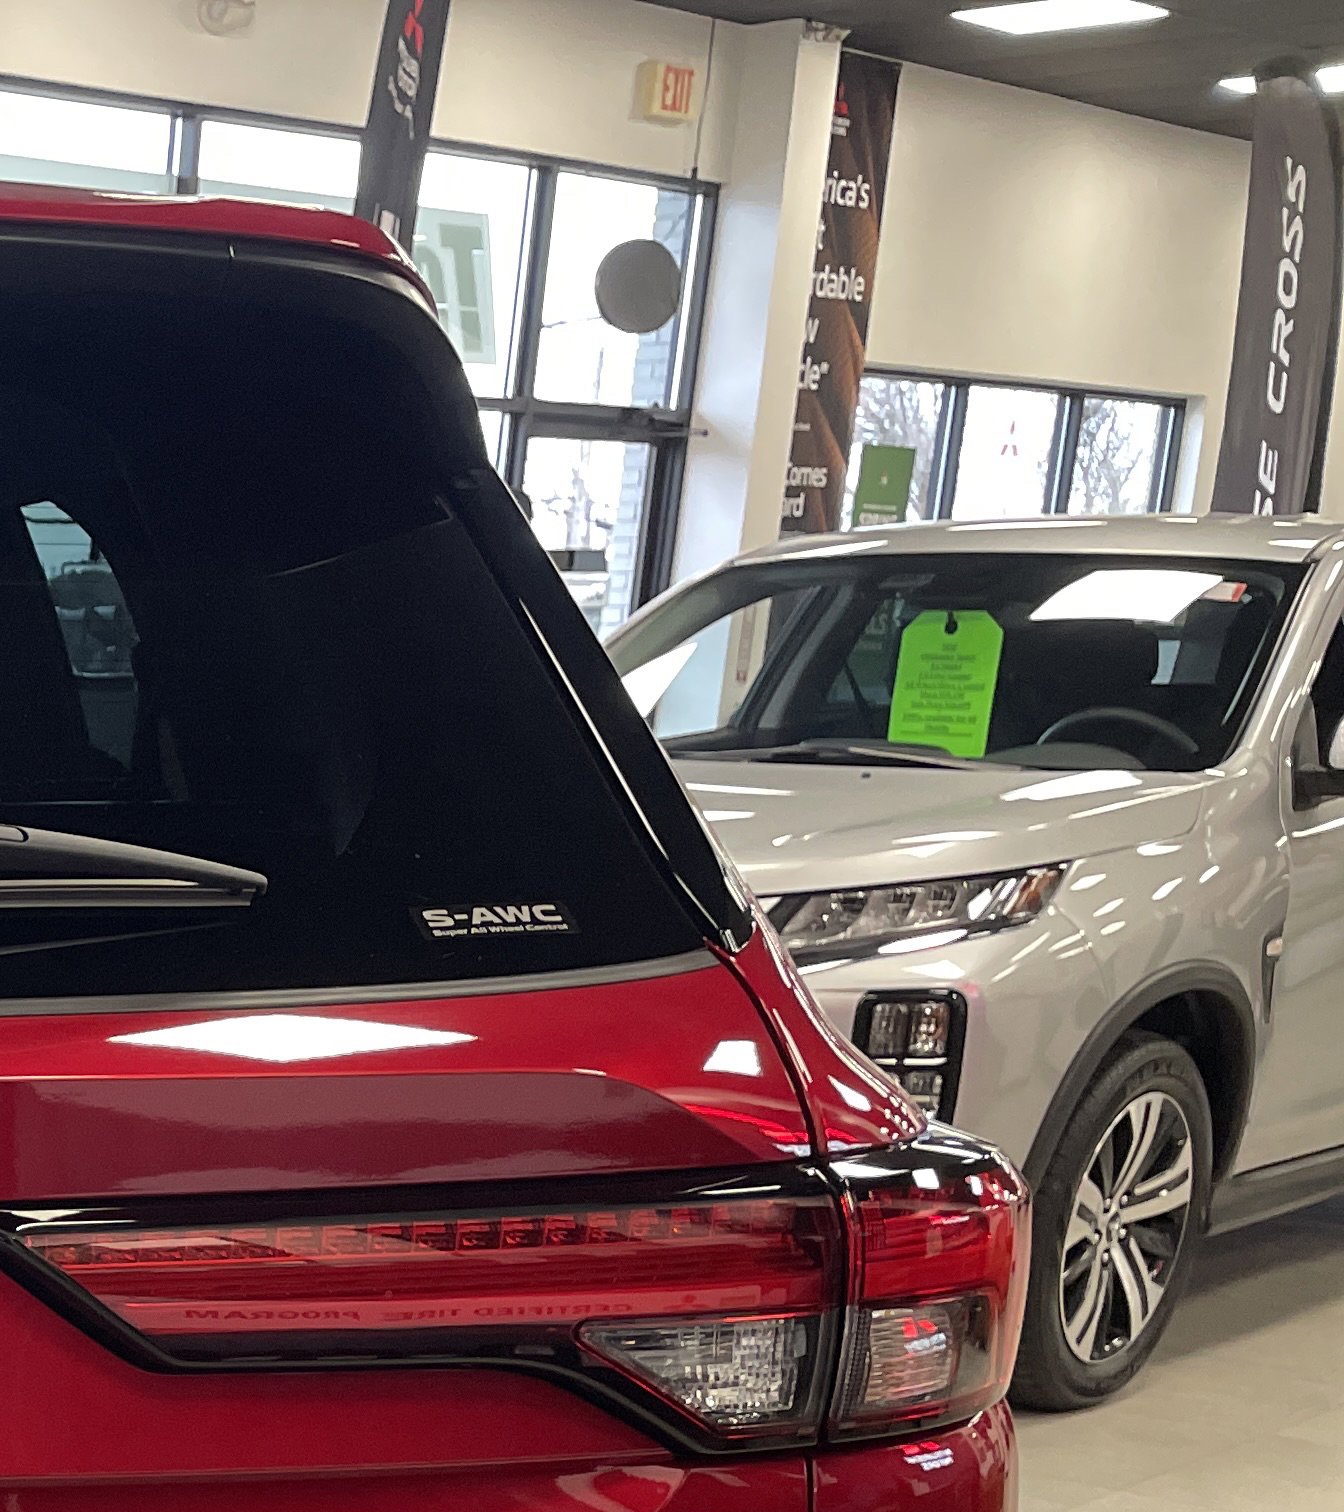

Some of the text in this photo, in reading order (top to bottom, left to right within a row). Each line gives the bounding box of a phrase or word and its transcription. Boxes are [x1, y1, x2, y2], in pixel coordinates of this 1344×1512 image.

[661, 64, 694, 114] EXIT
[1267, 156, 1307, 414] CROSS
[422, 904, 563, 929] S-AWC
